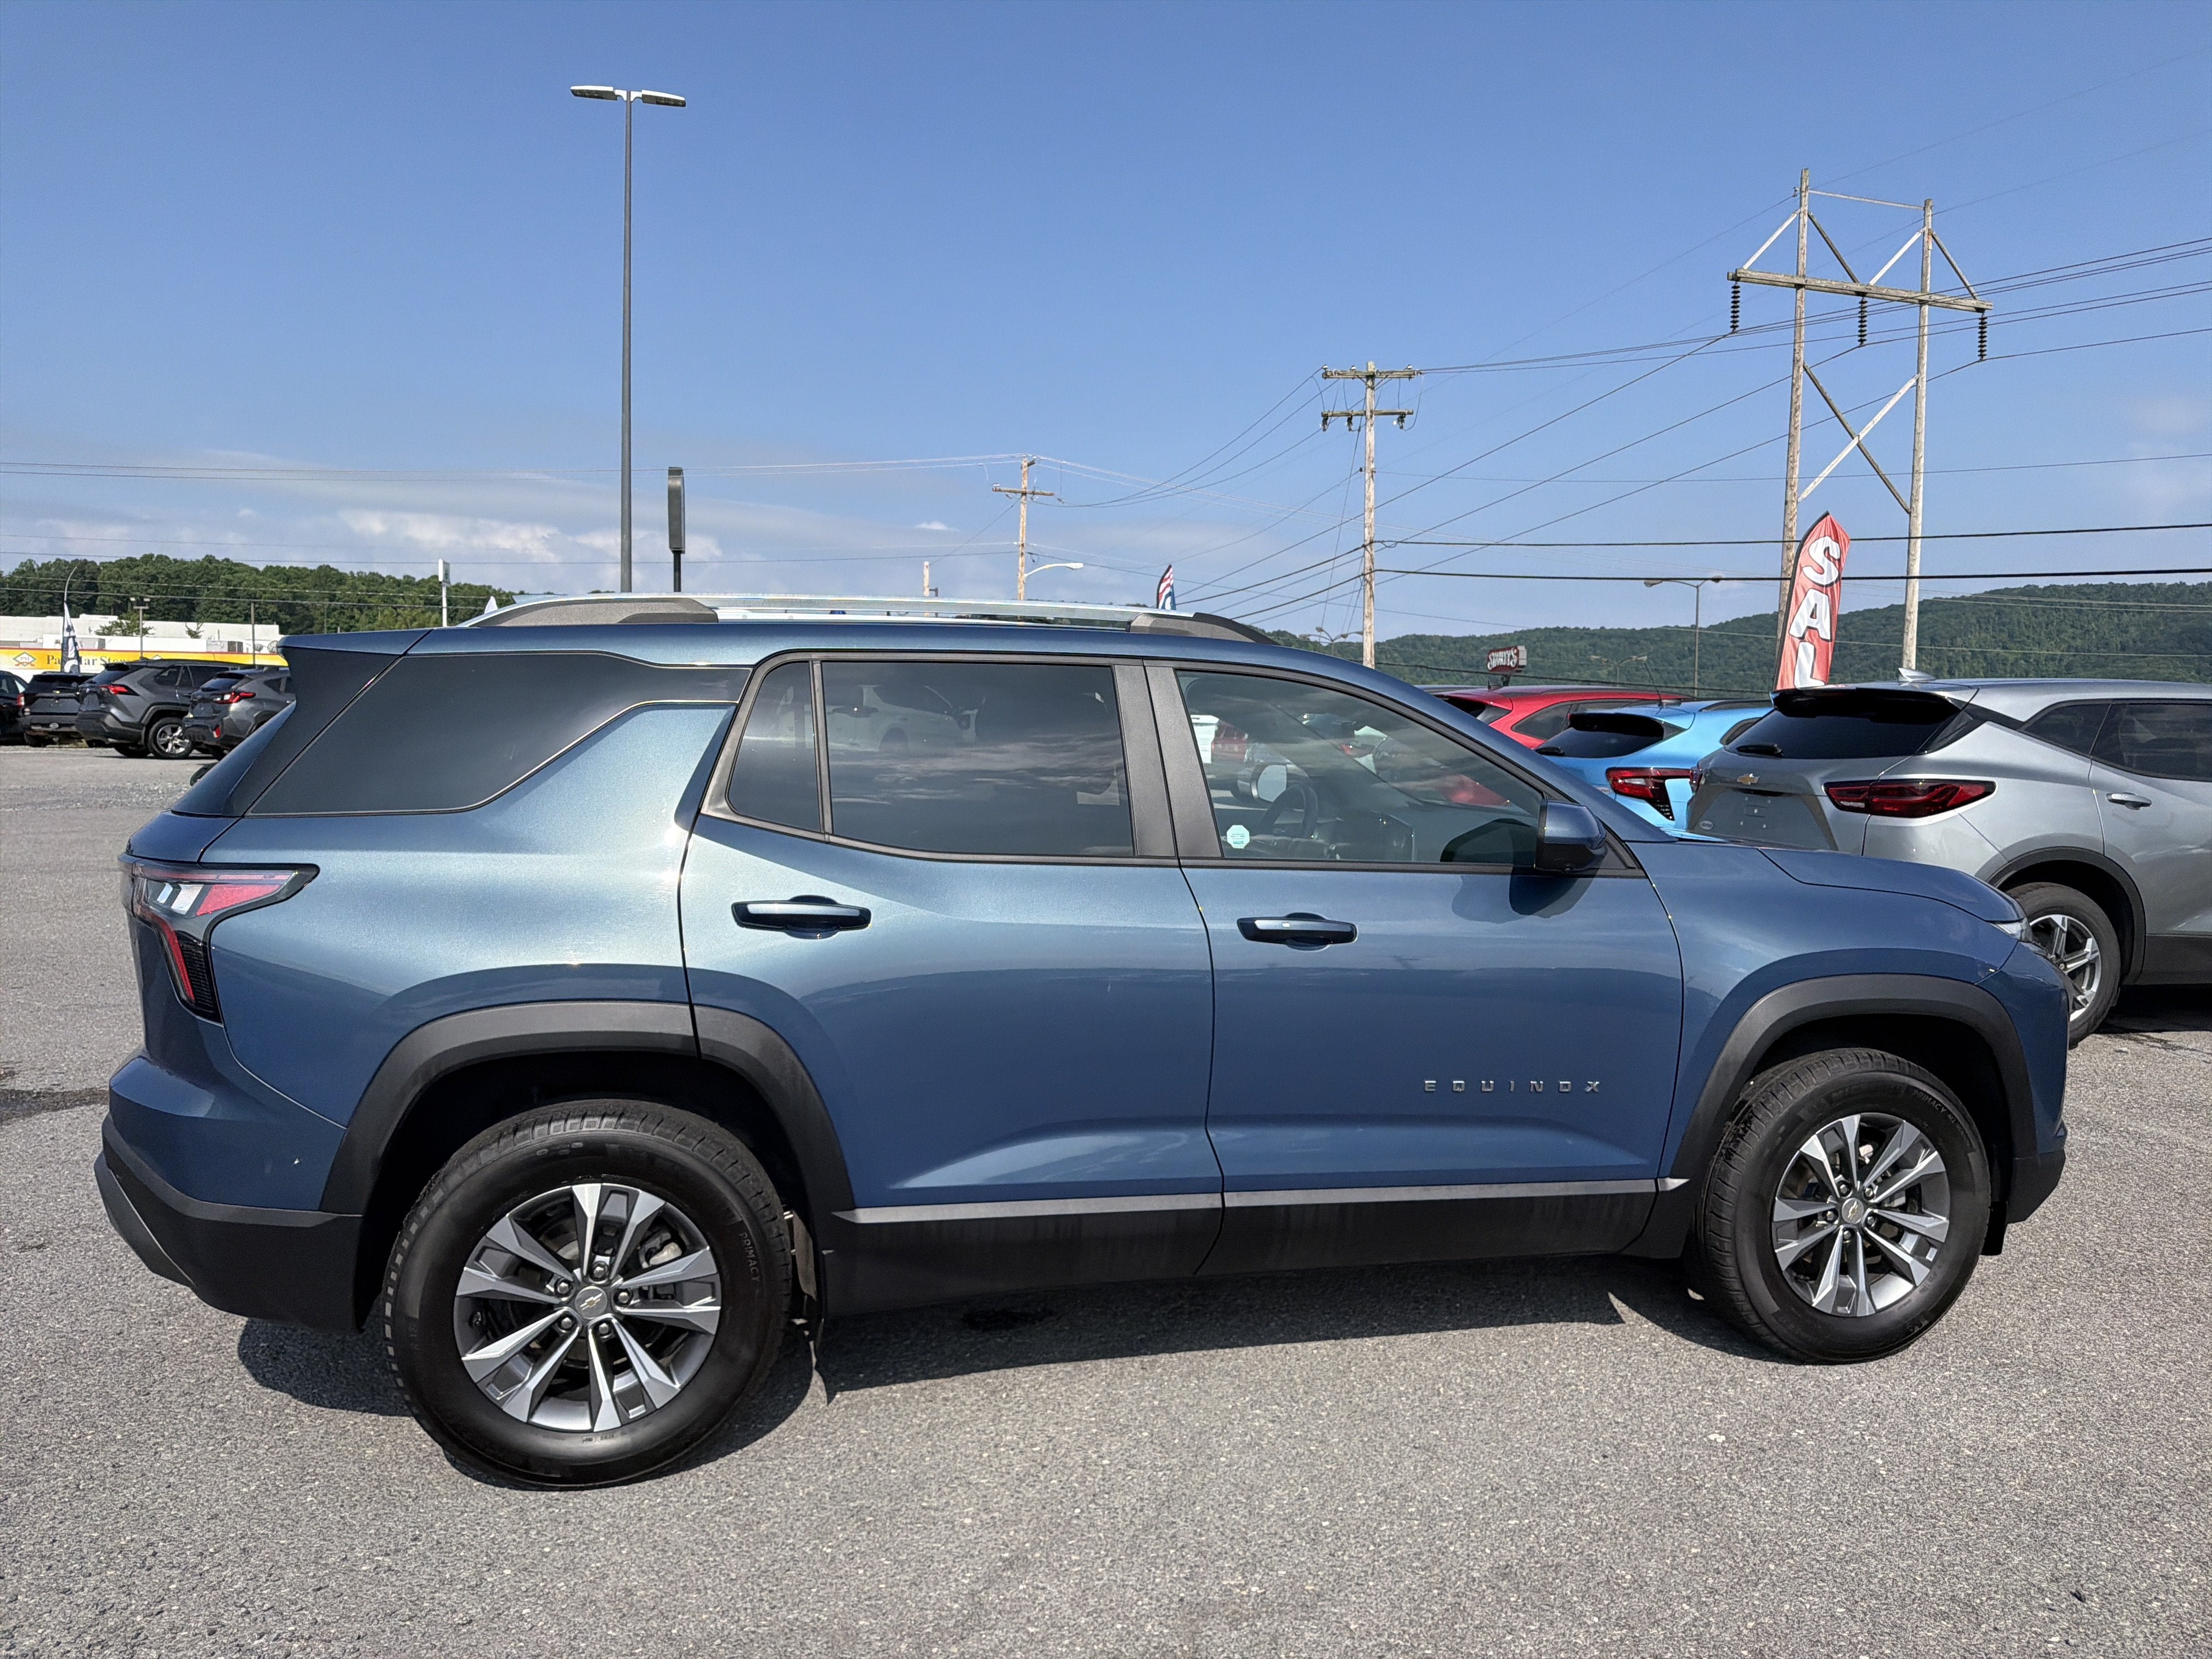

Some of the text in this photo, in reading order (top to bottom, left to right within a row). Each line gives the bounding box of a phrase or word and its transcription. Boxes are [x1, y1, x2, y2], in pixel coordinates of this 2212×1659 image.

[1789, 535, 1841, 689] SAL
[1425, 1080, 1600, 1092] EQUINOX
[738, 1232, 761, 1282] PRIMACY
